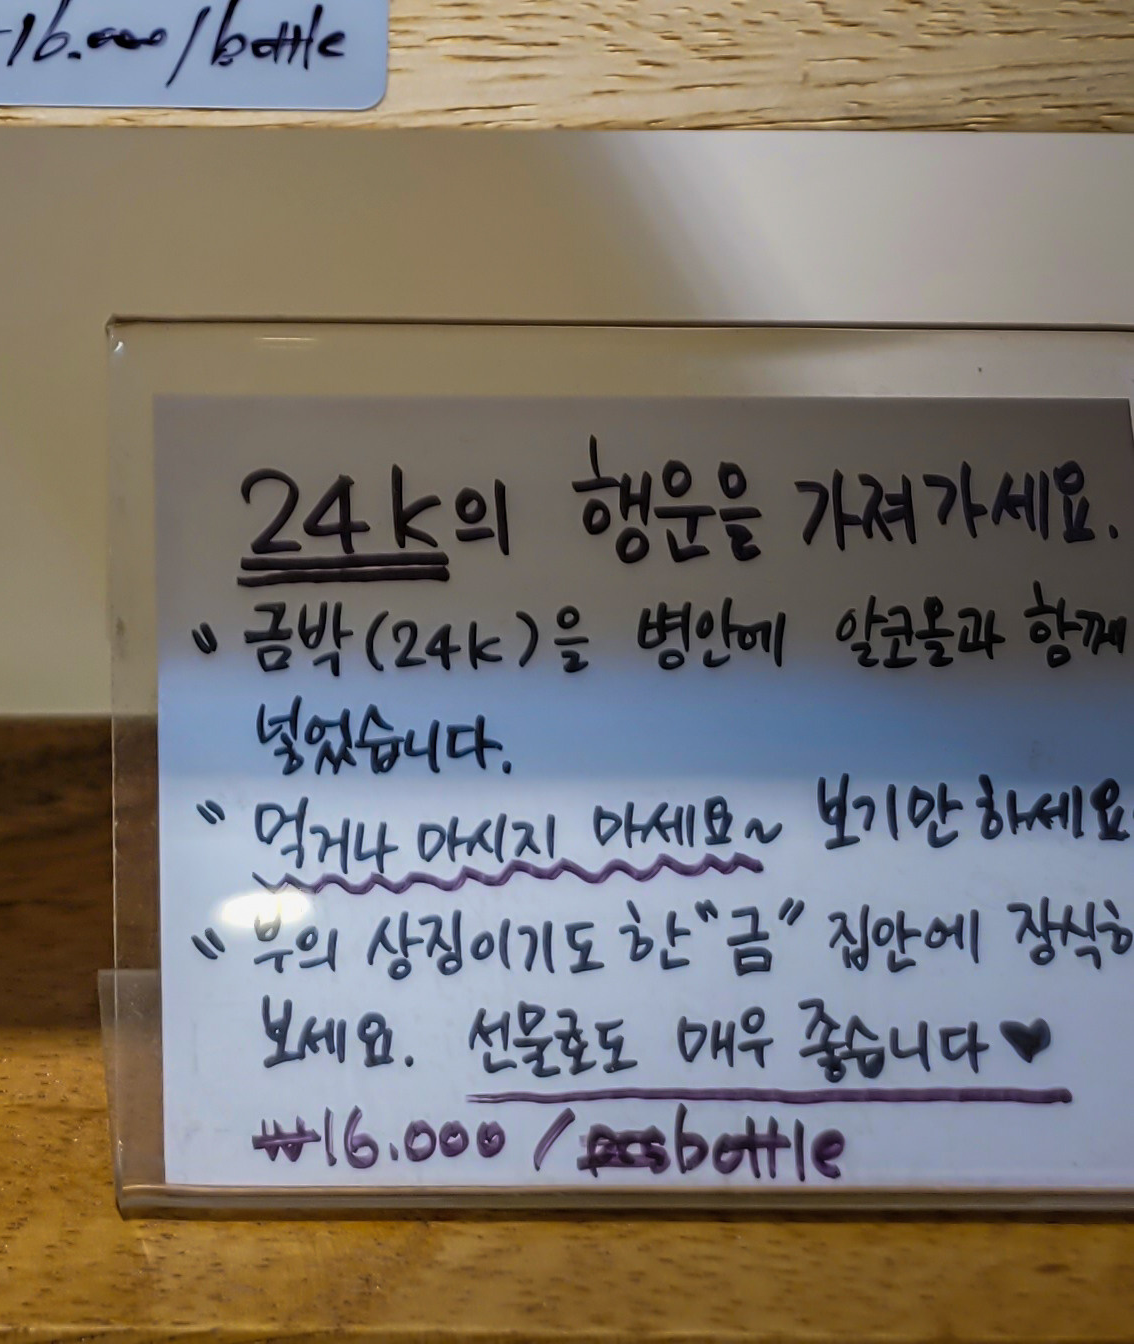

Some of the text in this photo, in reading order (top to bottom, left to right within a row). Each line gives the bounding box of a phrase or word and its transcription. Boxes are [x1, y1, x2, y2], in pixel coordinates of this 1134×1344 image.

[572, 434, 762, 564] 행운을
[794, 459, 1119, 552] 가져가세요.
[835, 594, 1005, 668] 알코올과
[256, 694, 512, 776] 넣었습니다.
[254, 796, 398, 874] 먹거나
[417, 812, 556, 864] 마시지
[367, 909, 605, 981] 상징이기도
[262, 994, 414, 1068] 보세요.
[677, 1005, 774, 1068] 매우
